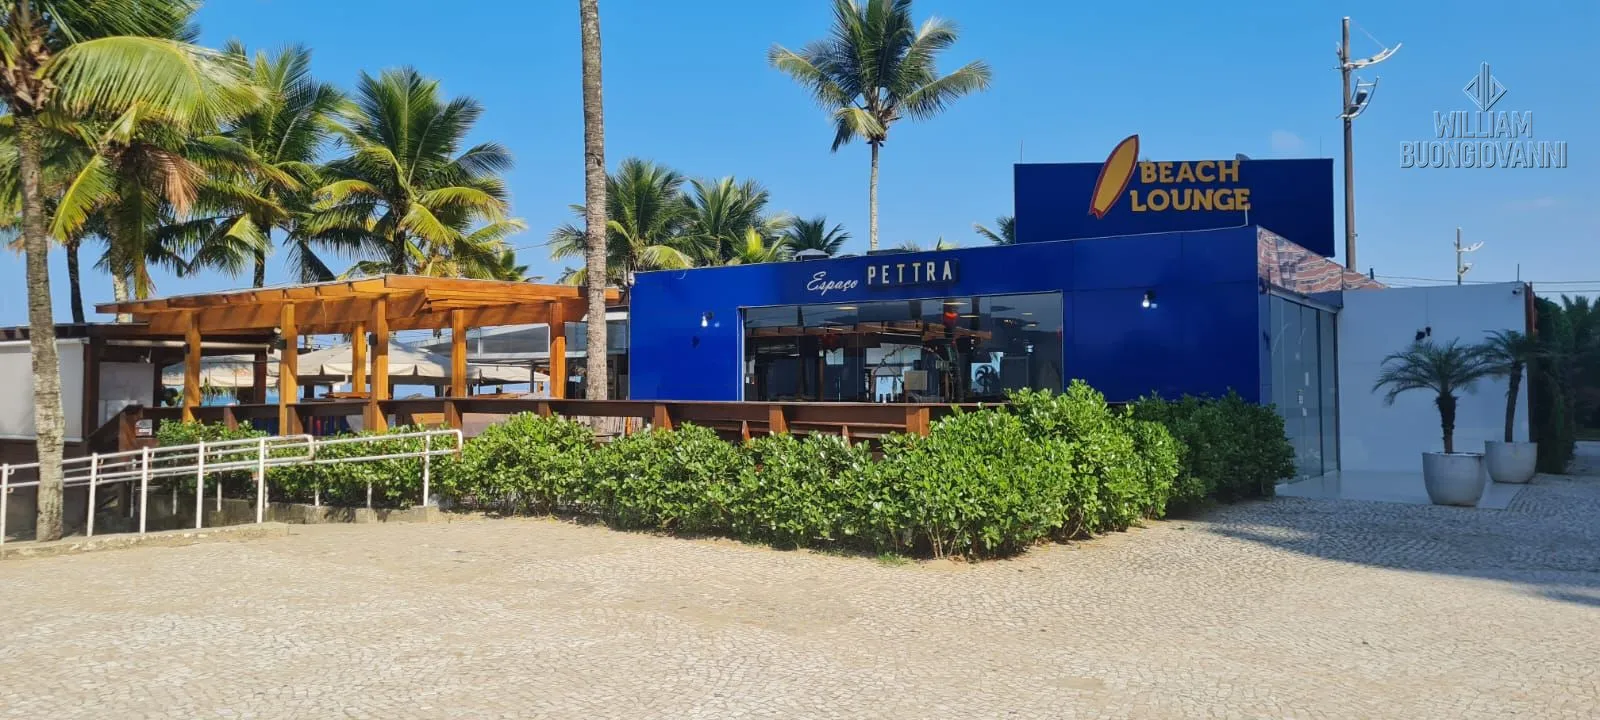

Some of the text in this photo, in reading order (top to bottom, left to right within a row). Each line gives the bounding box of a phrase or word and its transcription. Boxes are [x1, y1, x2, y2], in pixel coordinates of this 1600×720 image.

[1139, 160, 1240, 184] BEACH
[1130, 188, 1251, 212] LOUNGE
[807, 260, 952, 295] Espaço PETTRA
